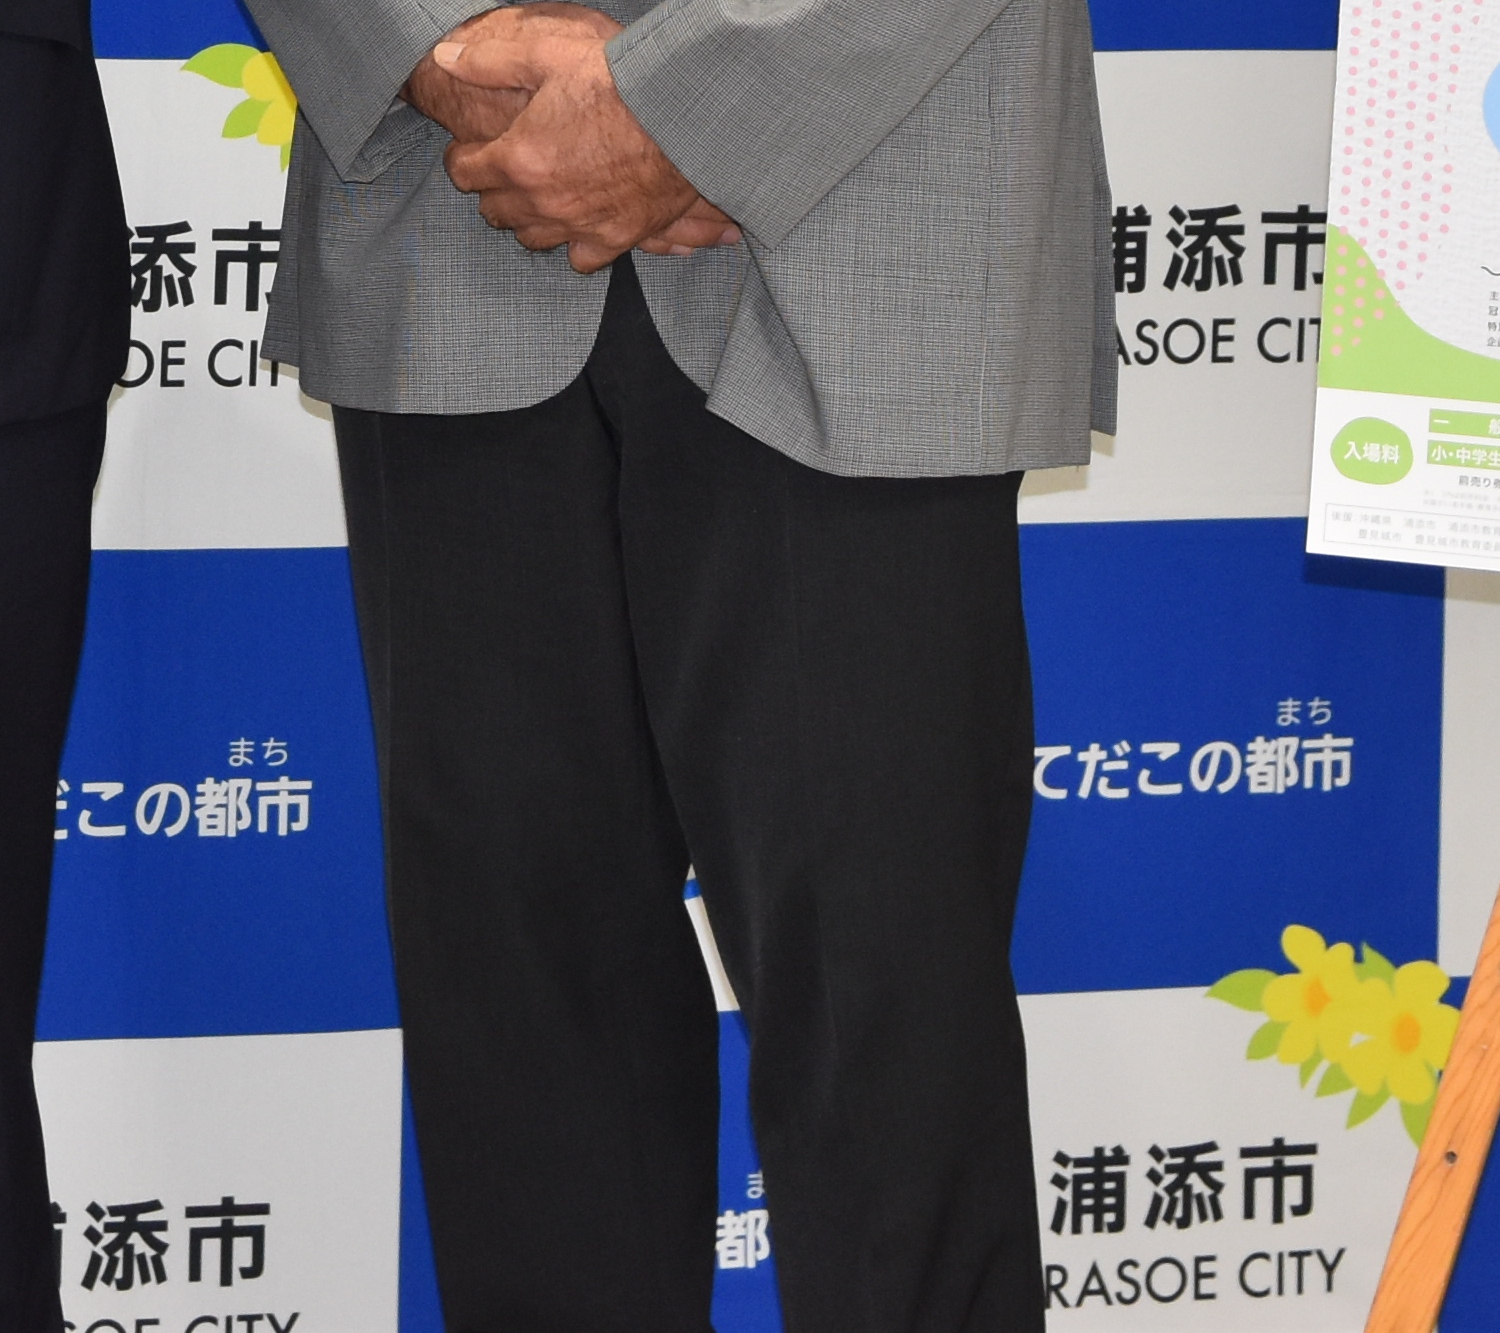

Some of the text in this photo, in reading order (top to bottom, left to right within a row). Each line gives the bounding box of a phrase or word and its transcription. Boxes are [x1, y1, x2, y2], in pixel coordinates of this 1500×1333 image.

[129, 220, 281, 312] 添市
[1344, 441, 1400, 464] 入場料
[1277, 697, 1332, 727] まち
[229, 737, 288, 766] まち
[1034, 734, 1354, 799] てだこの都市
[54, 776, 312, 840] この都市
[1050, 1138, 1317, 1235] 浦添市
[51, 1196, 270, 1291] 添市
[1045, 1248, 1345, 1309] RASOE CITY
